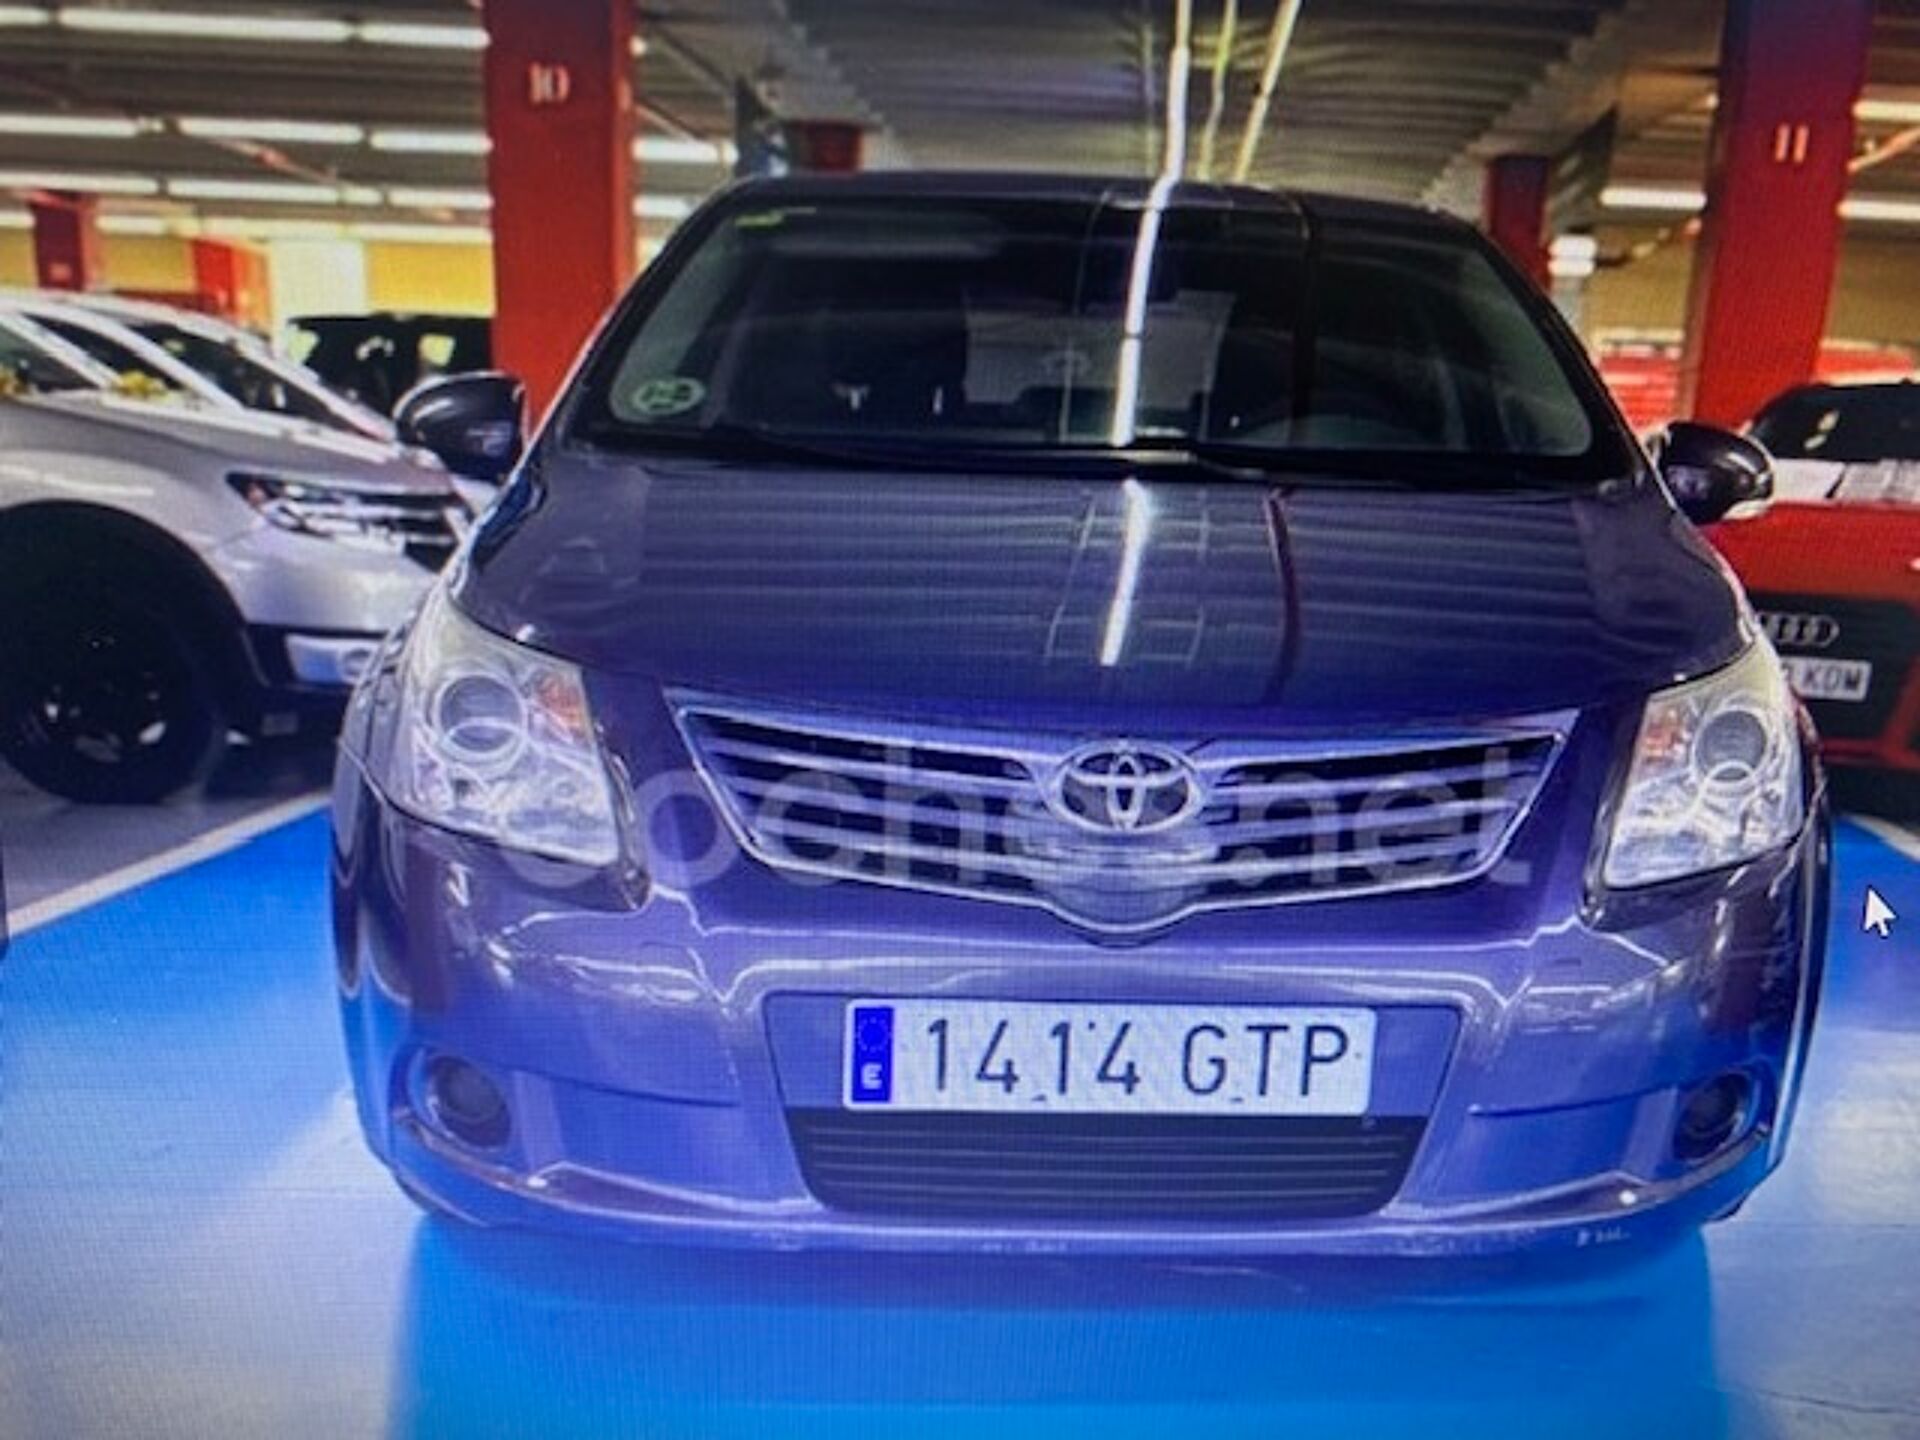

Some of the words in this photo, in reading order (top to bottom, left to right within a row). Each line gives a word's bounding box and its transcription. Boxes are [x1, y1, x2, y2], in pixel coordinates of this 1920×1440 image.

[530, 62, 570, 102] 10
[1775, 123, 1809, 162] 11
[860, 1063, 883, 1090] E
[926, 1018, 1141, 1096] 1414
[1181, 1023, 1350, 1098] GTP
